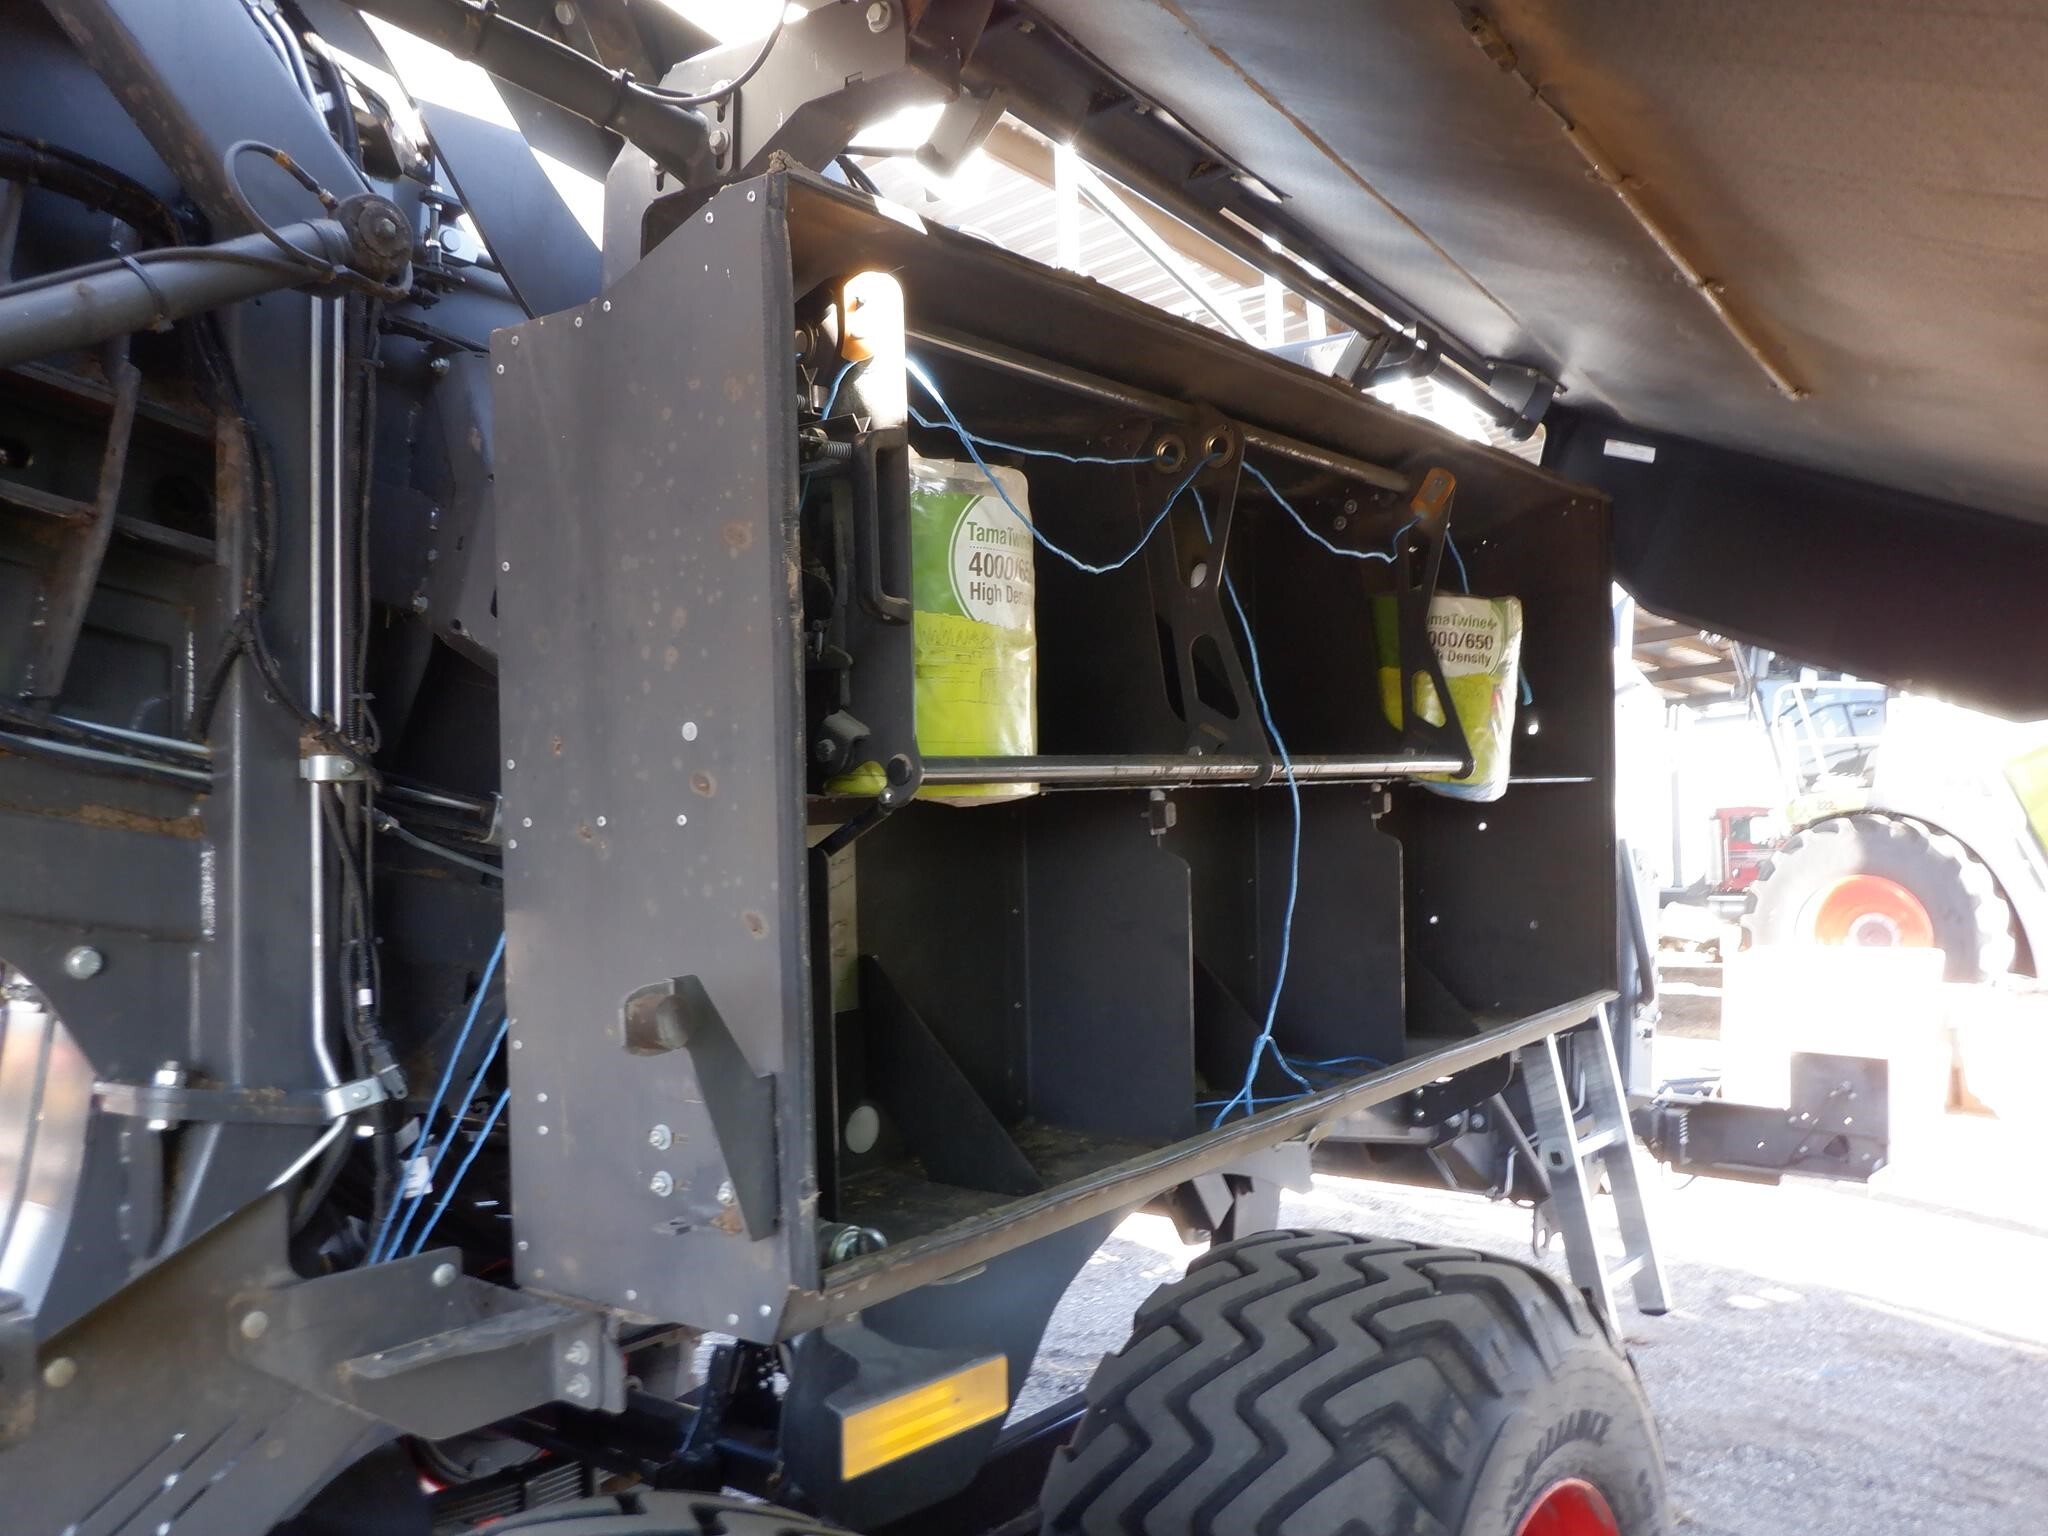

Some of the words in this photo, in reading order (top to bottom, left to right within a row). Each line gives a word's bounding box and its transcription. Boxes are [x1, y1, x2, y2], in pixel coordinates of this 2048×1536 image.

[970, 581, 1002, 606] High
[1428, 630, 1494, 651] 000/650
[1447, 649, 1492, 668] Density
